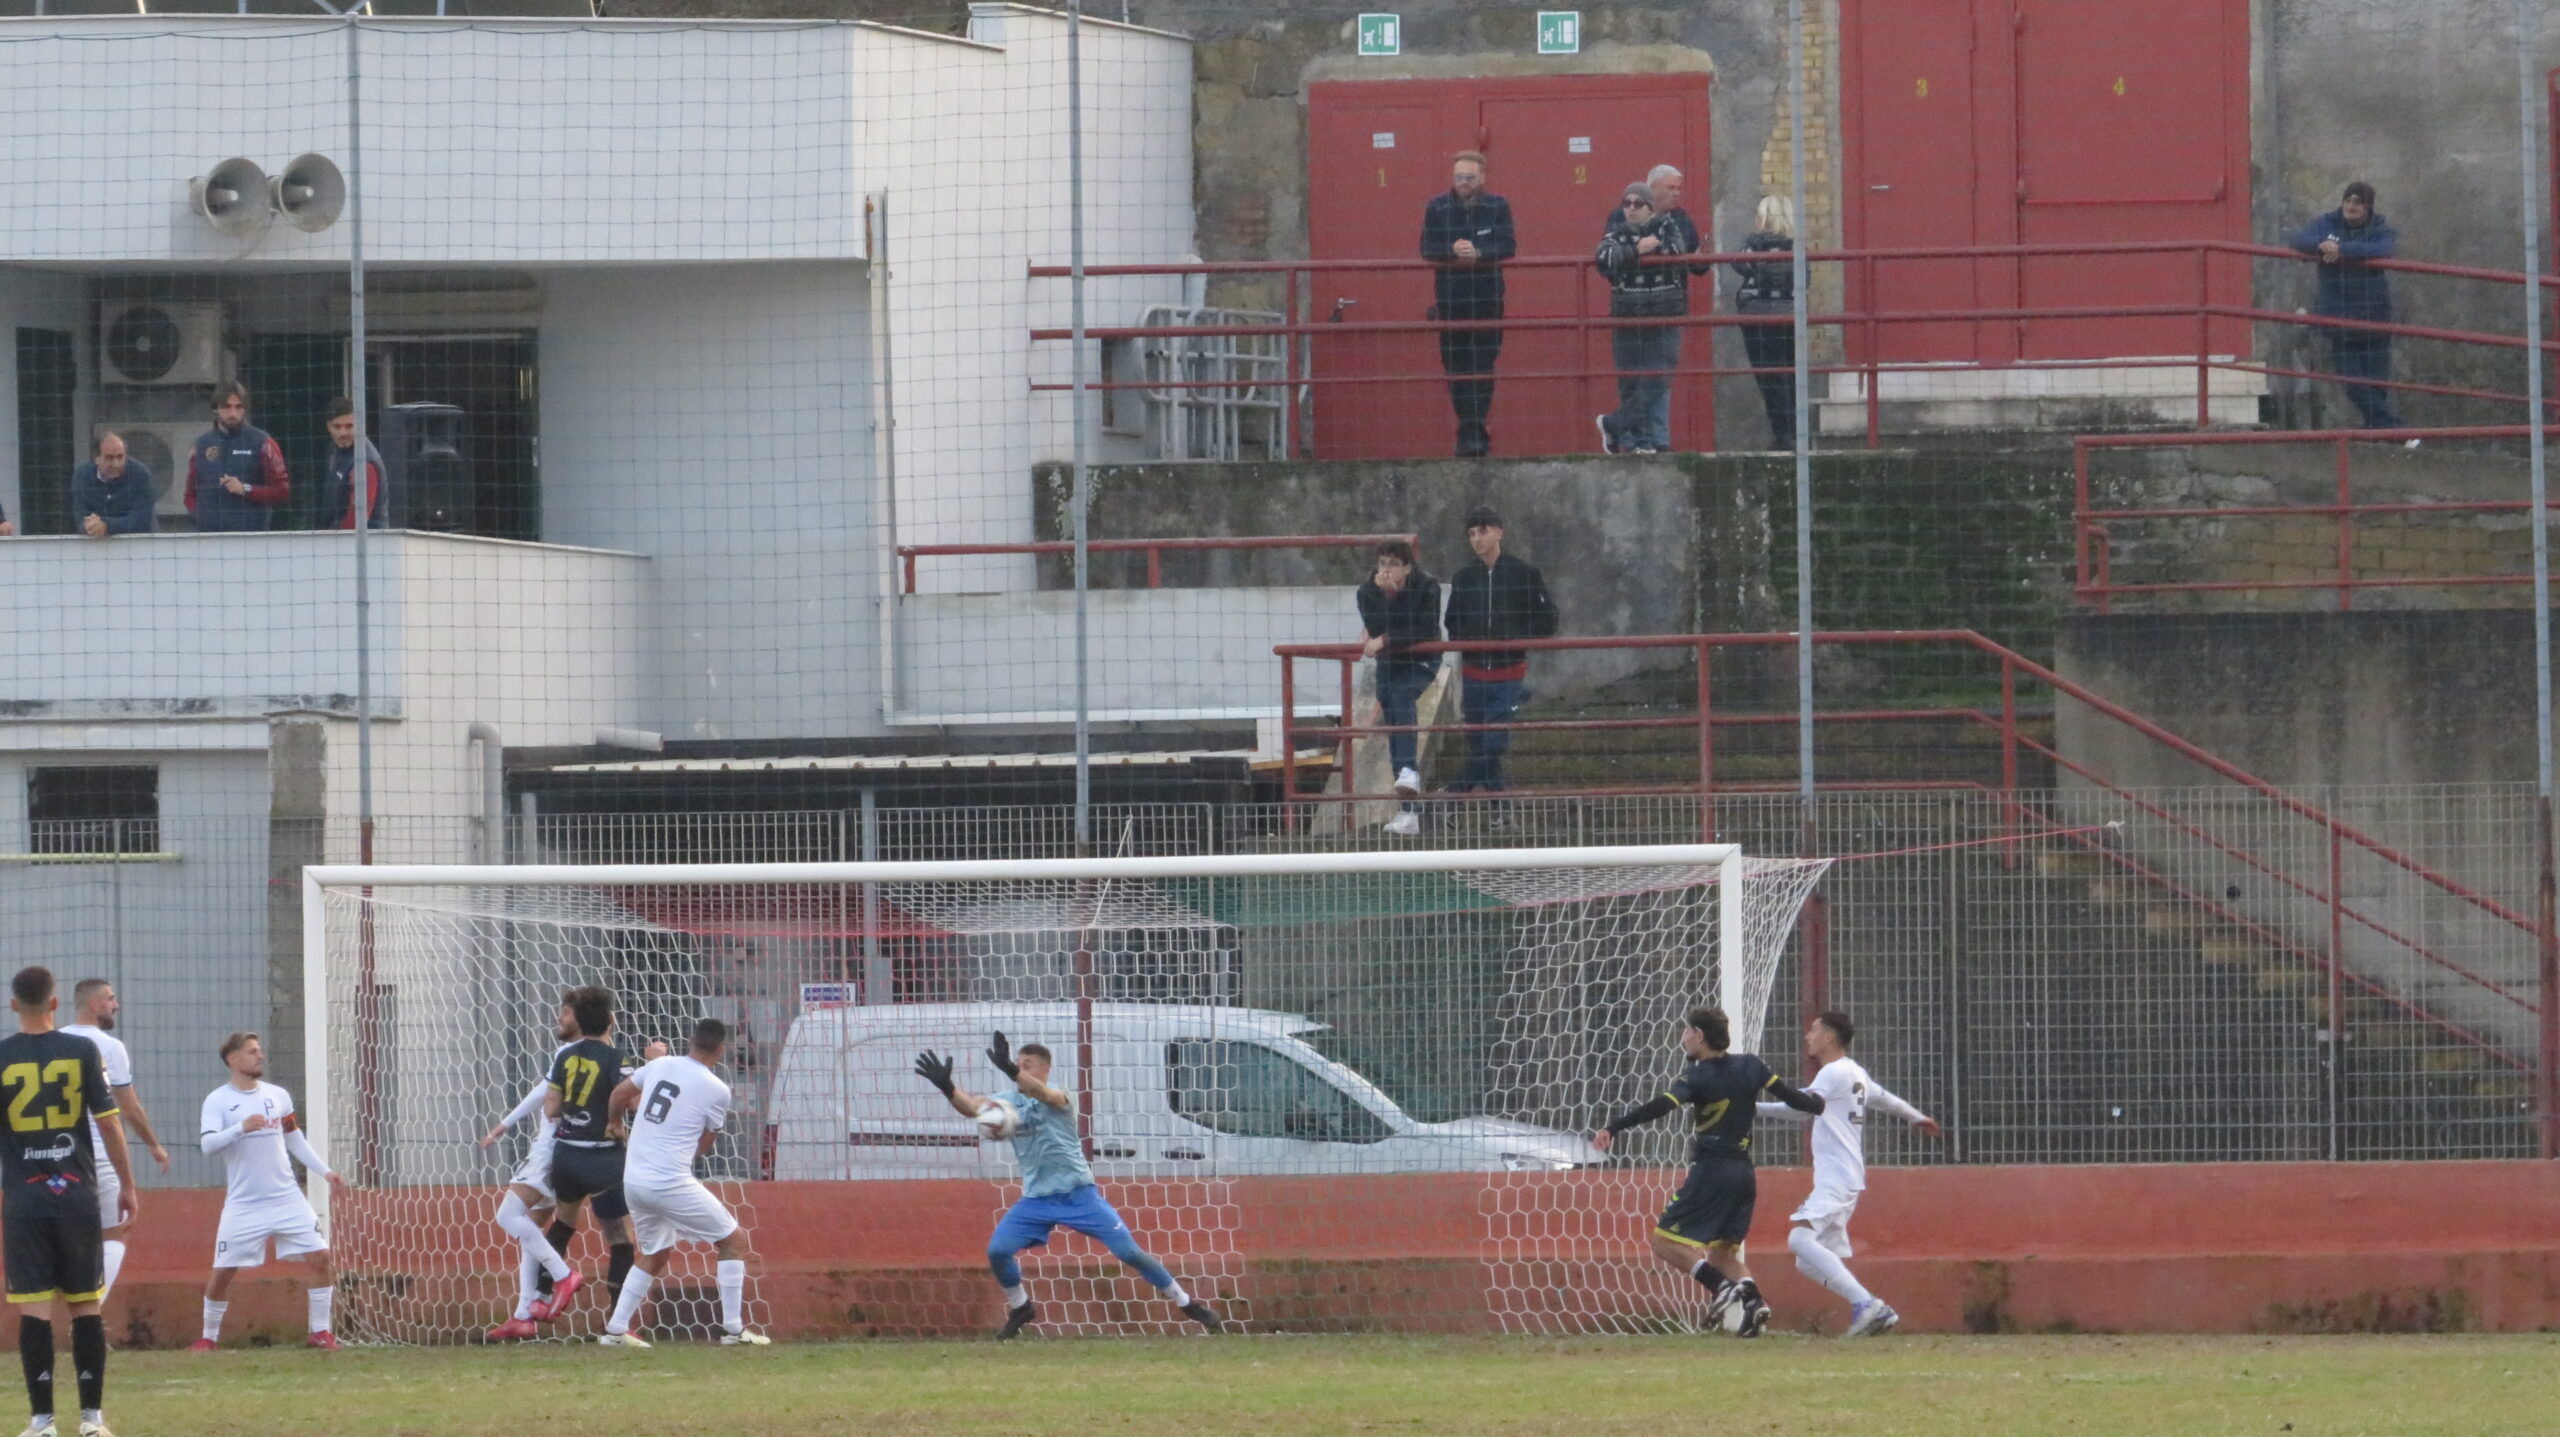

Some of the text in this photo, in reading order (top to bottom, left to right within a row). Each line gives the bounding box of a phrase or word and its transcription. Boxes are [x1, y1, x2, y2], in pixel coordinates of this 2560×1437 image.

[1916, 77, 1928, 97] 3
[2112, 76, 2127, 96] 4
[1377, 168, 1388, 187] 1
[1574, 165, 1587, 184] 2
[2, 1059, 82, 1132] 23
[564, 1055, 600, 1107] 17
[644, 1080, 680, 1125] 6
[1848, 1081, 1866, 1125] 3
